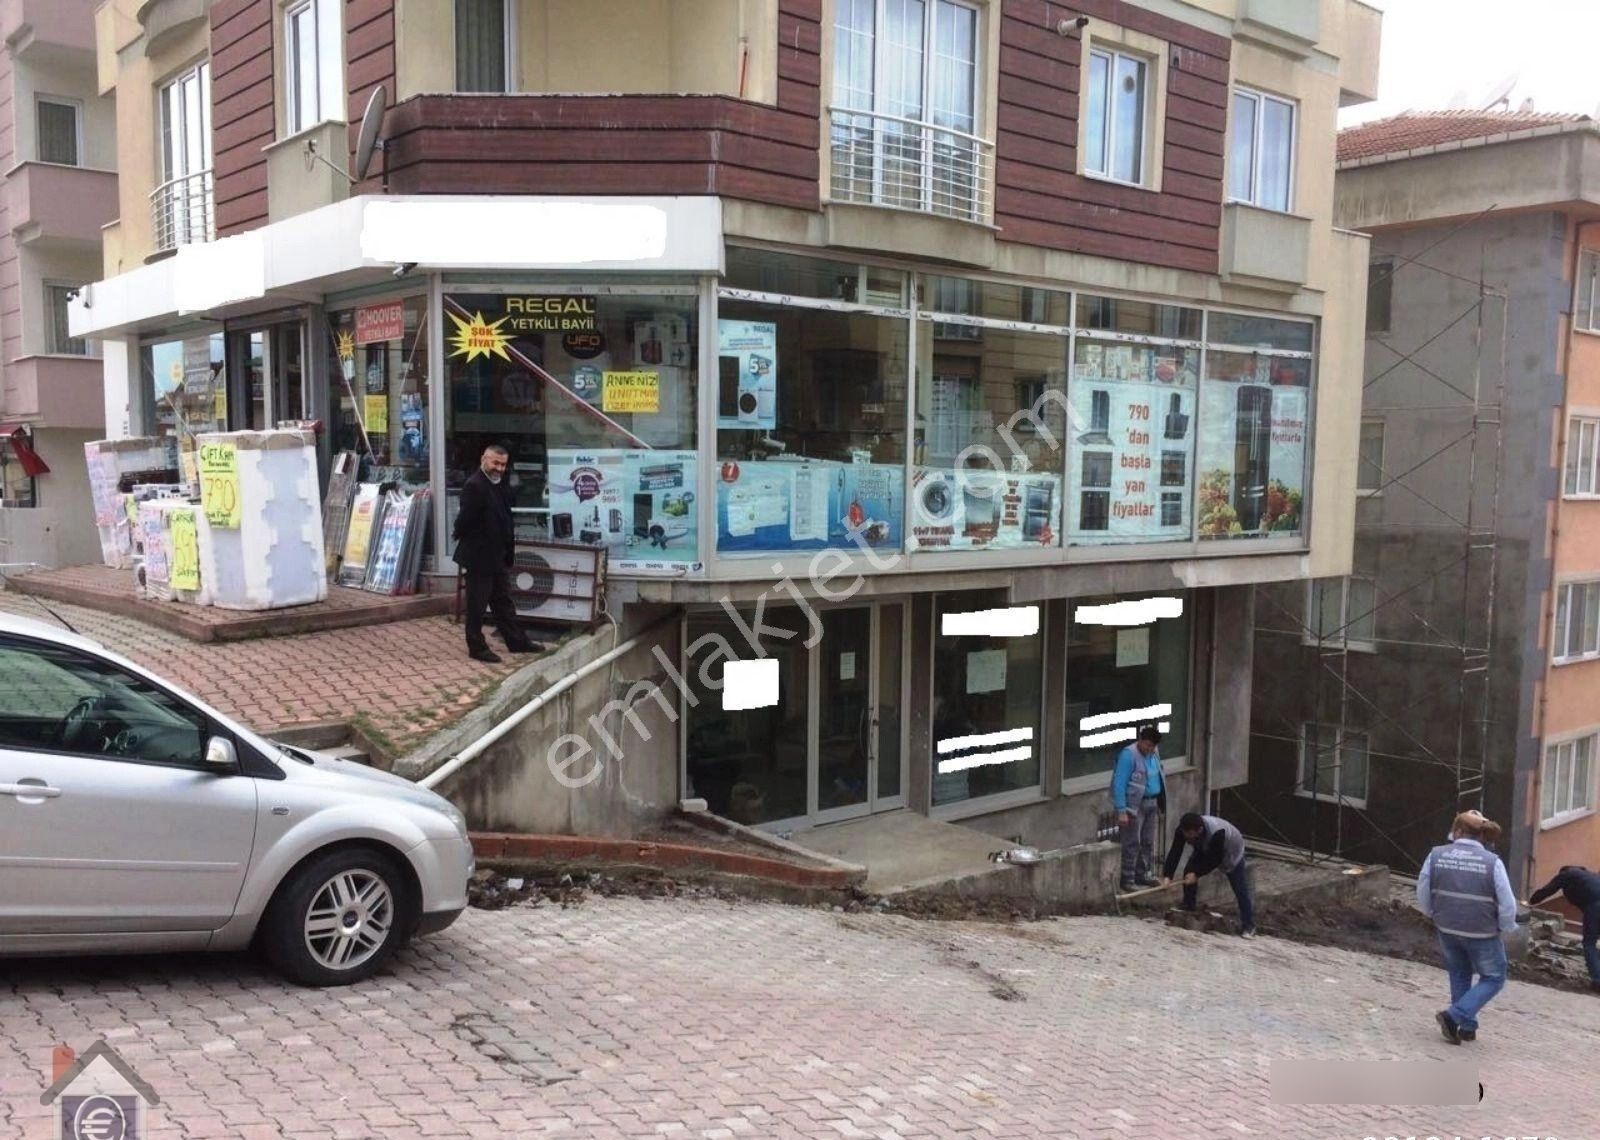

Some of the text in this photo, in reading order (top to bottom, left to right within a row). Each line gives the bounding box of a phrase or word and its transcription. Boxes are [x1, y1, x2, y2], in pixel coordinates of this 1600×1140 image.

[506, 298, 595, 313] REGAL
[367, 305, 402, 325] HOOVER
[511, 317, 559, 329] YETKİLİ
[1128, 404, 1150, 420] 790
[1120, 453, 1151, 470] başla
[1125, 480, 1145, 496] yan
[1112, 501, 1154, 518] fiyatlar
